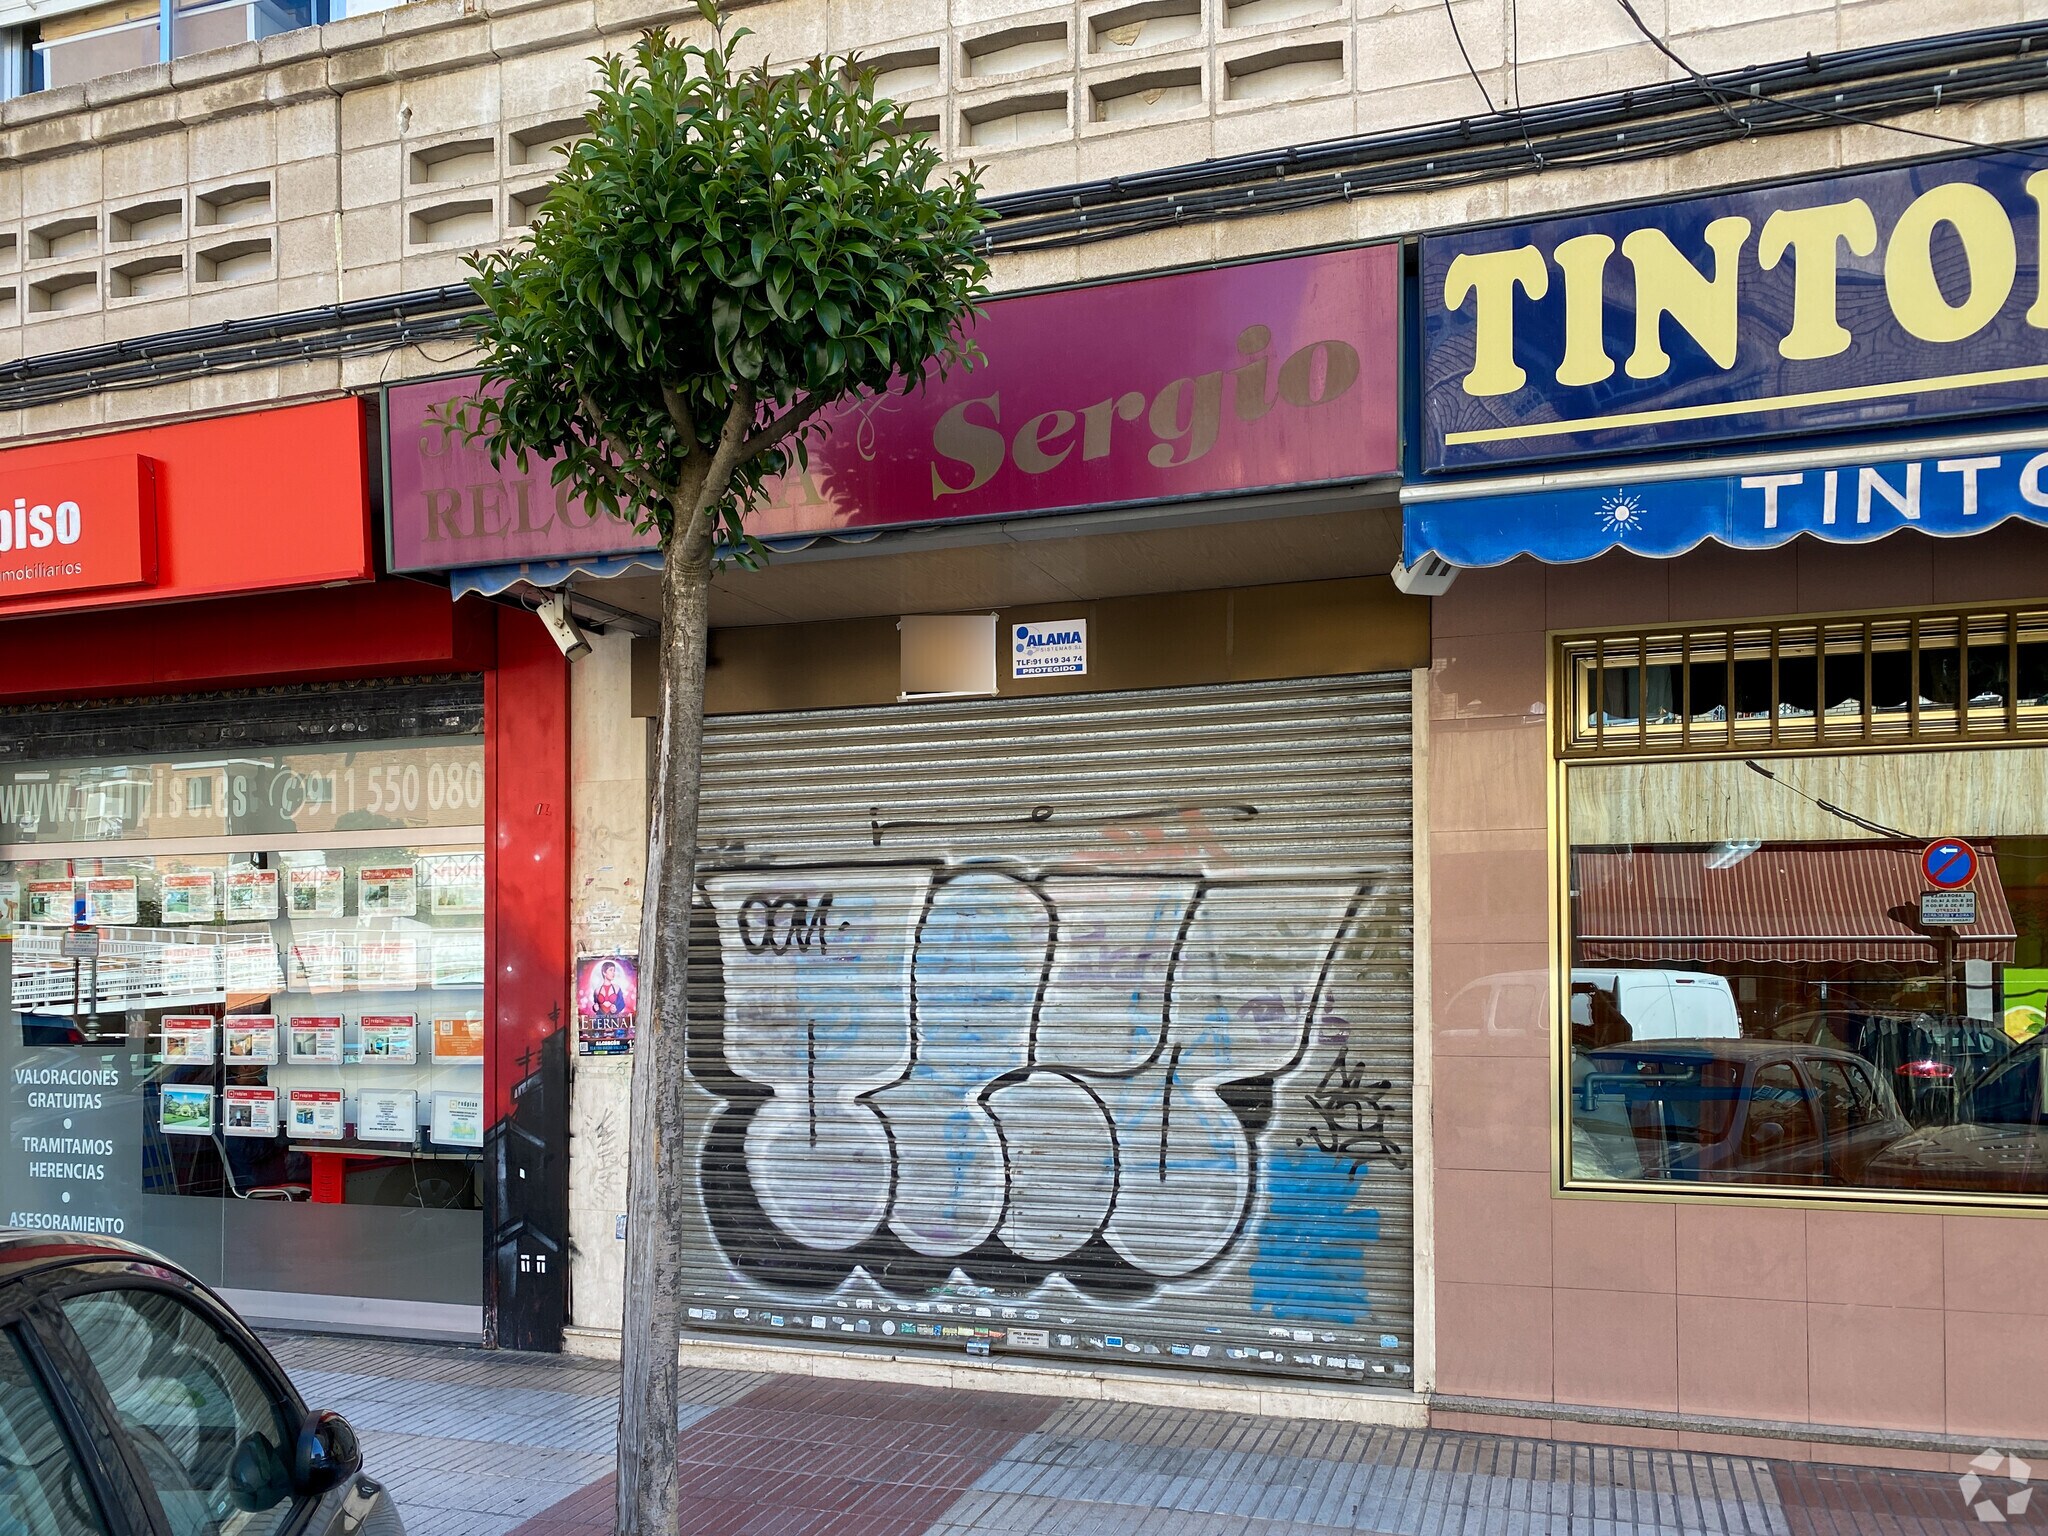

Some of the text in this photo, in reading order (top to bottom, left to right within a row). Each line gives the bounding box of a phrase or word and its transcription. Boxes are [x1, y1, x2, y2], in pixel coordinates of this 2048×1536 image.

[930, 324, 1361, 501] Sergio
[0, 561, 82, 582] mobiliarios
[1027, 631, 1082, 647] ALAMA
[1040, 645, 1072, 653] SISTEMAS
[1016, 658, 1042, 666] TLF:91
[1045, 656, 1059, 664] 619
[1022, 665, 1077, 675] PROTEGIDO
[307, 768, 356, 816] 911
[367, 764, 420, 813] 550
[428, 761, 483, 811] 080
[581, 1012, 636, 1031] ETERNAL
[14, 1069, 119, 1086] VALORACIONES
[27, 1092, 102, 1109] GRATUITAS
[22, 1136, 114, 1156] TRAMITAMOS
[29, 1161, 105, 1180] HERENCIAS
[9, 1211, 125, 1234] ASESORAMIENTO
